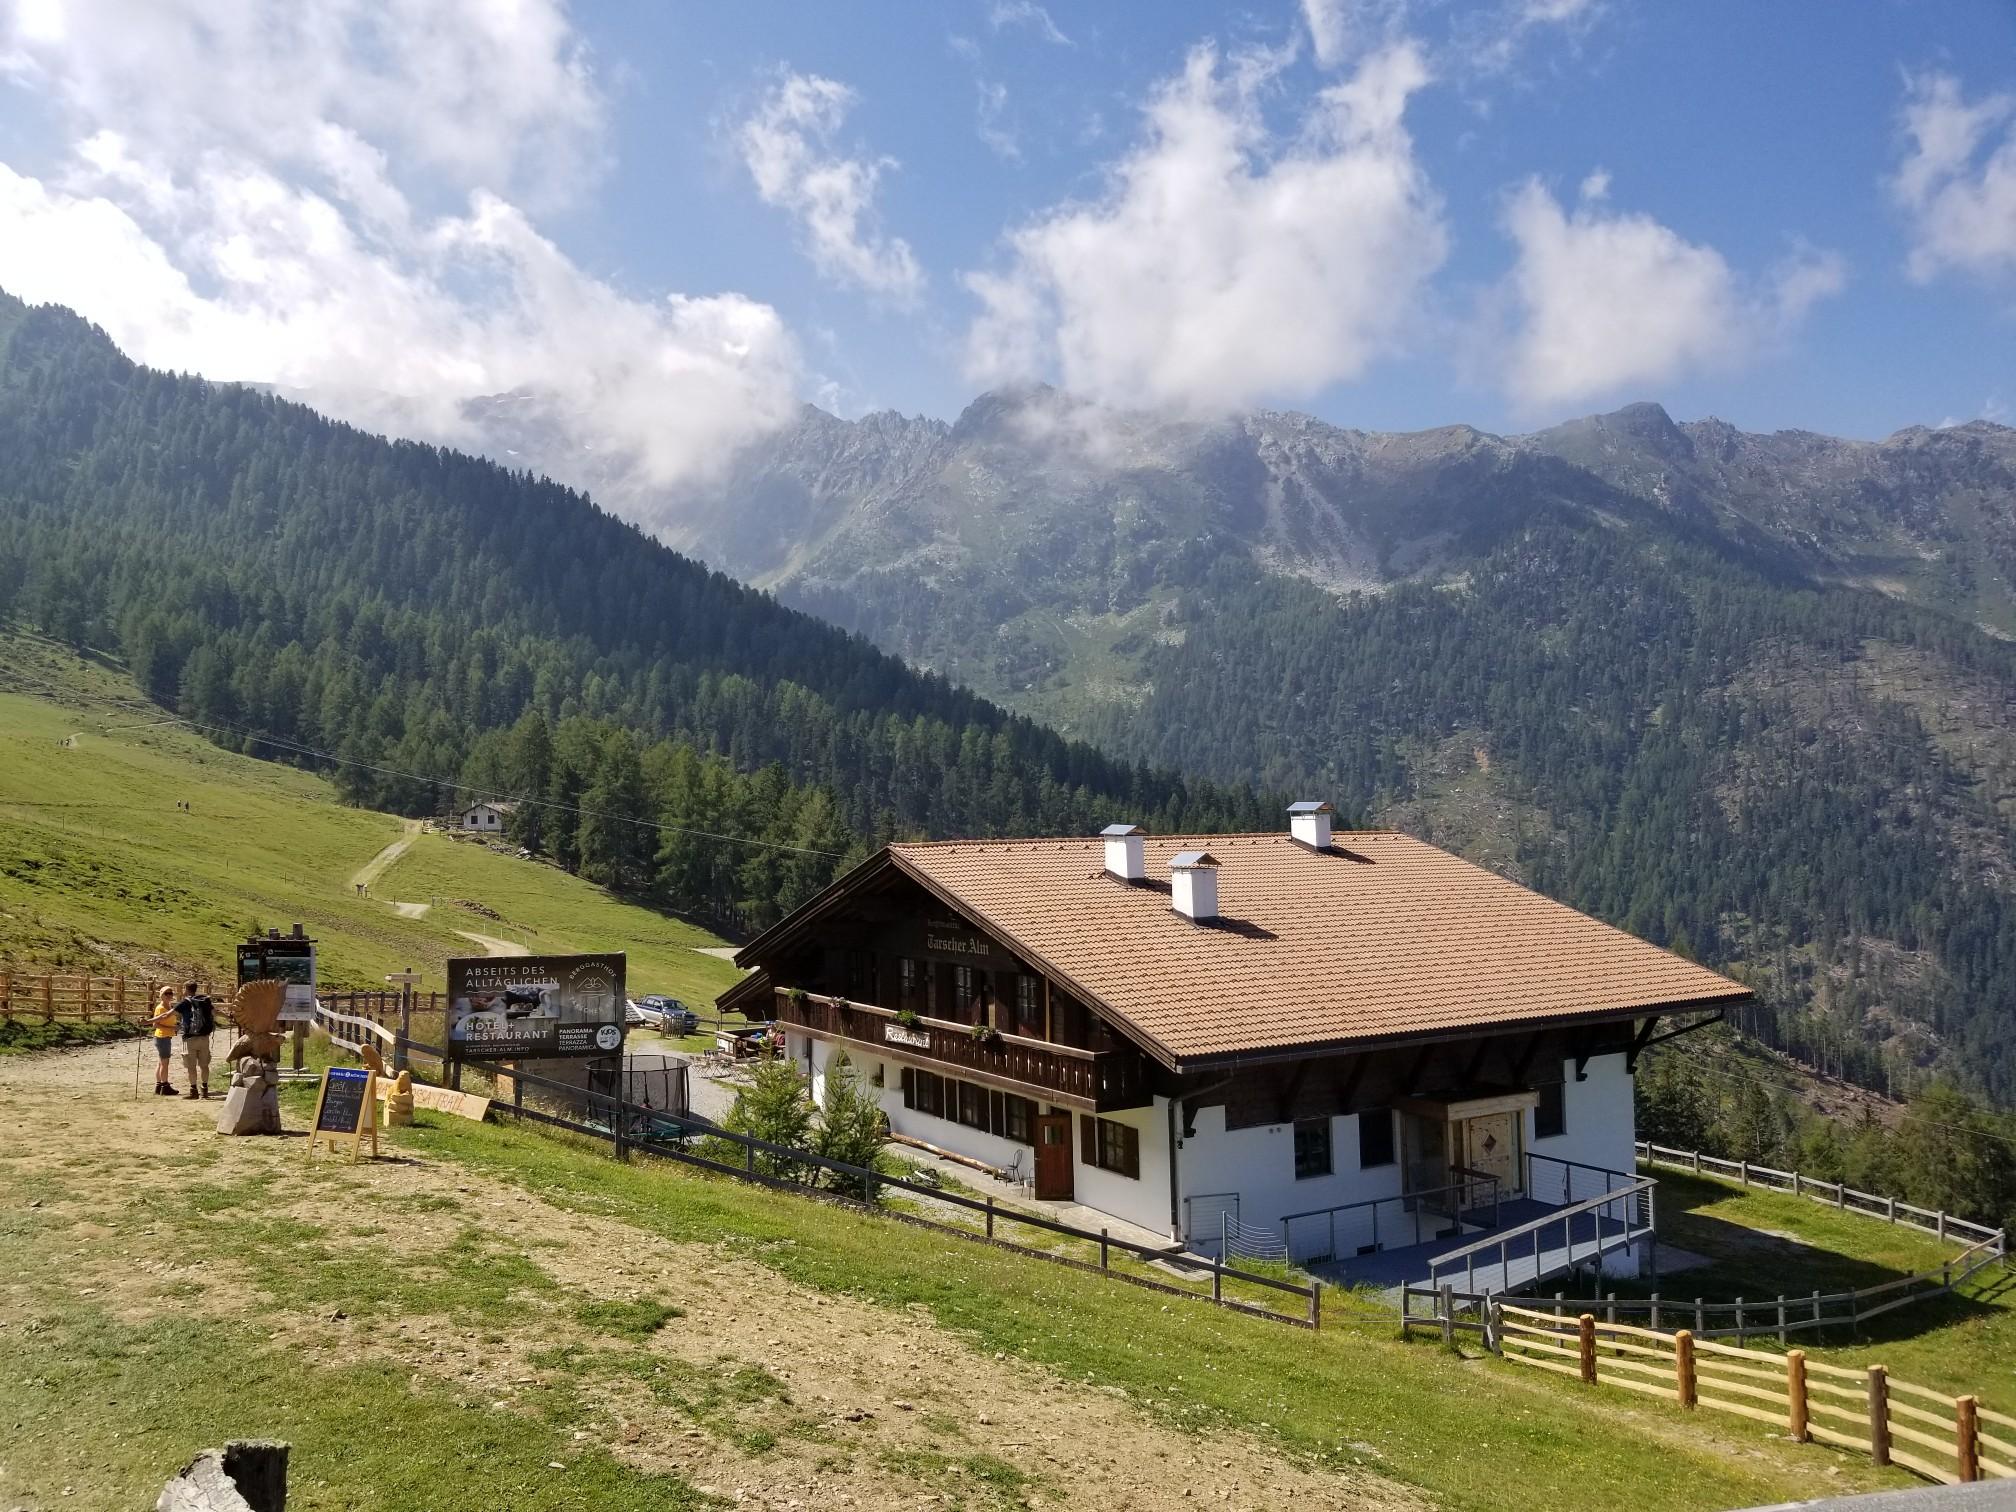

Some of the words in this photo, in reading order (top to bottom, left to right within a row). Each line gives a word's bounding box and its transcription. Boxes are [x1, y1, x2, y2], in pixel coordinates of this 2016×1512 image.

[969, 938, 990, 956] Alm
[466, 967, 517, 976] ABSEITS
[522, 966, 545, 975] DES
[569, 962, 617, 980] BERGGASTHOF
[466, 976, 558, 988] ALLTÄGLICHEN
[466, 1030, 549, 1041] RESTAURANT
[886, 1027, 930, 1048] Restaurant
